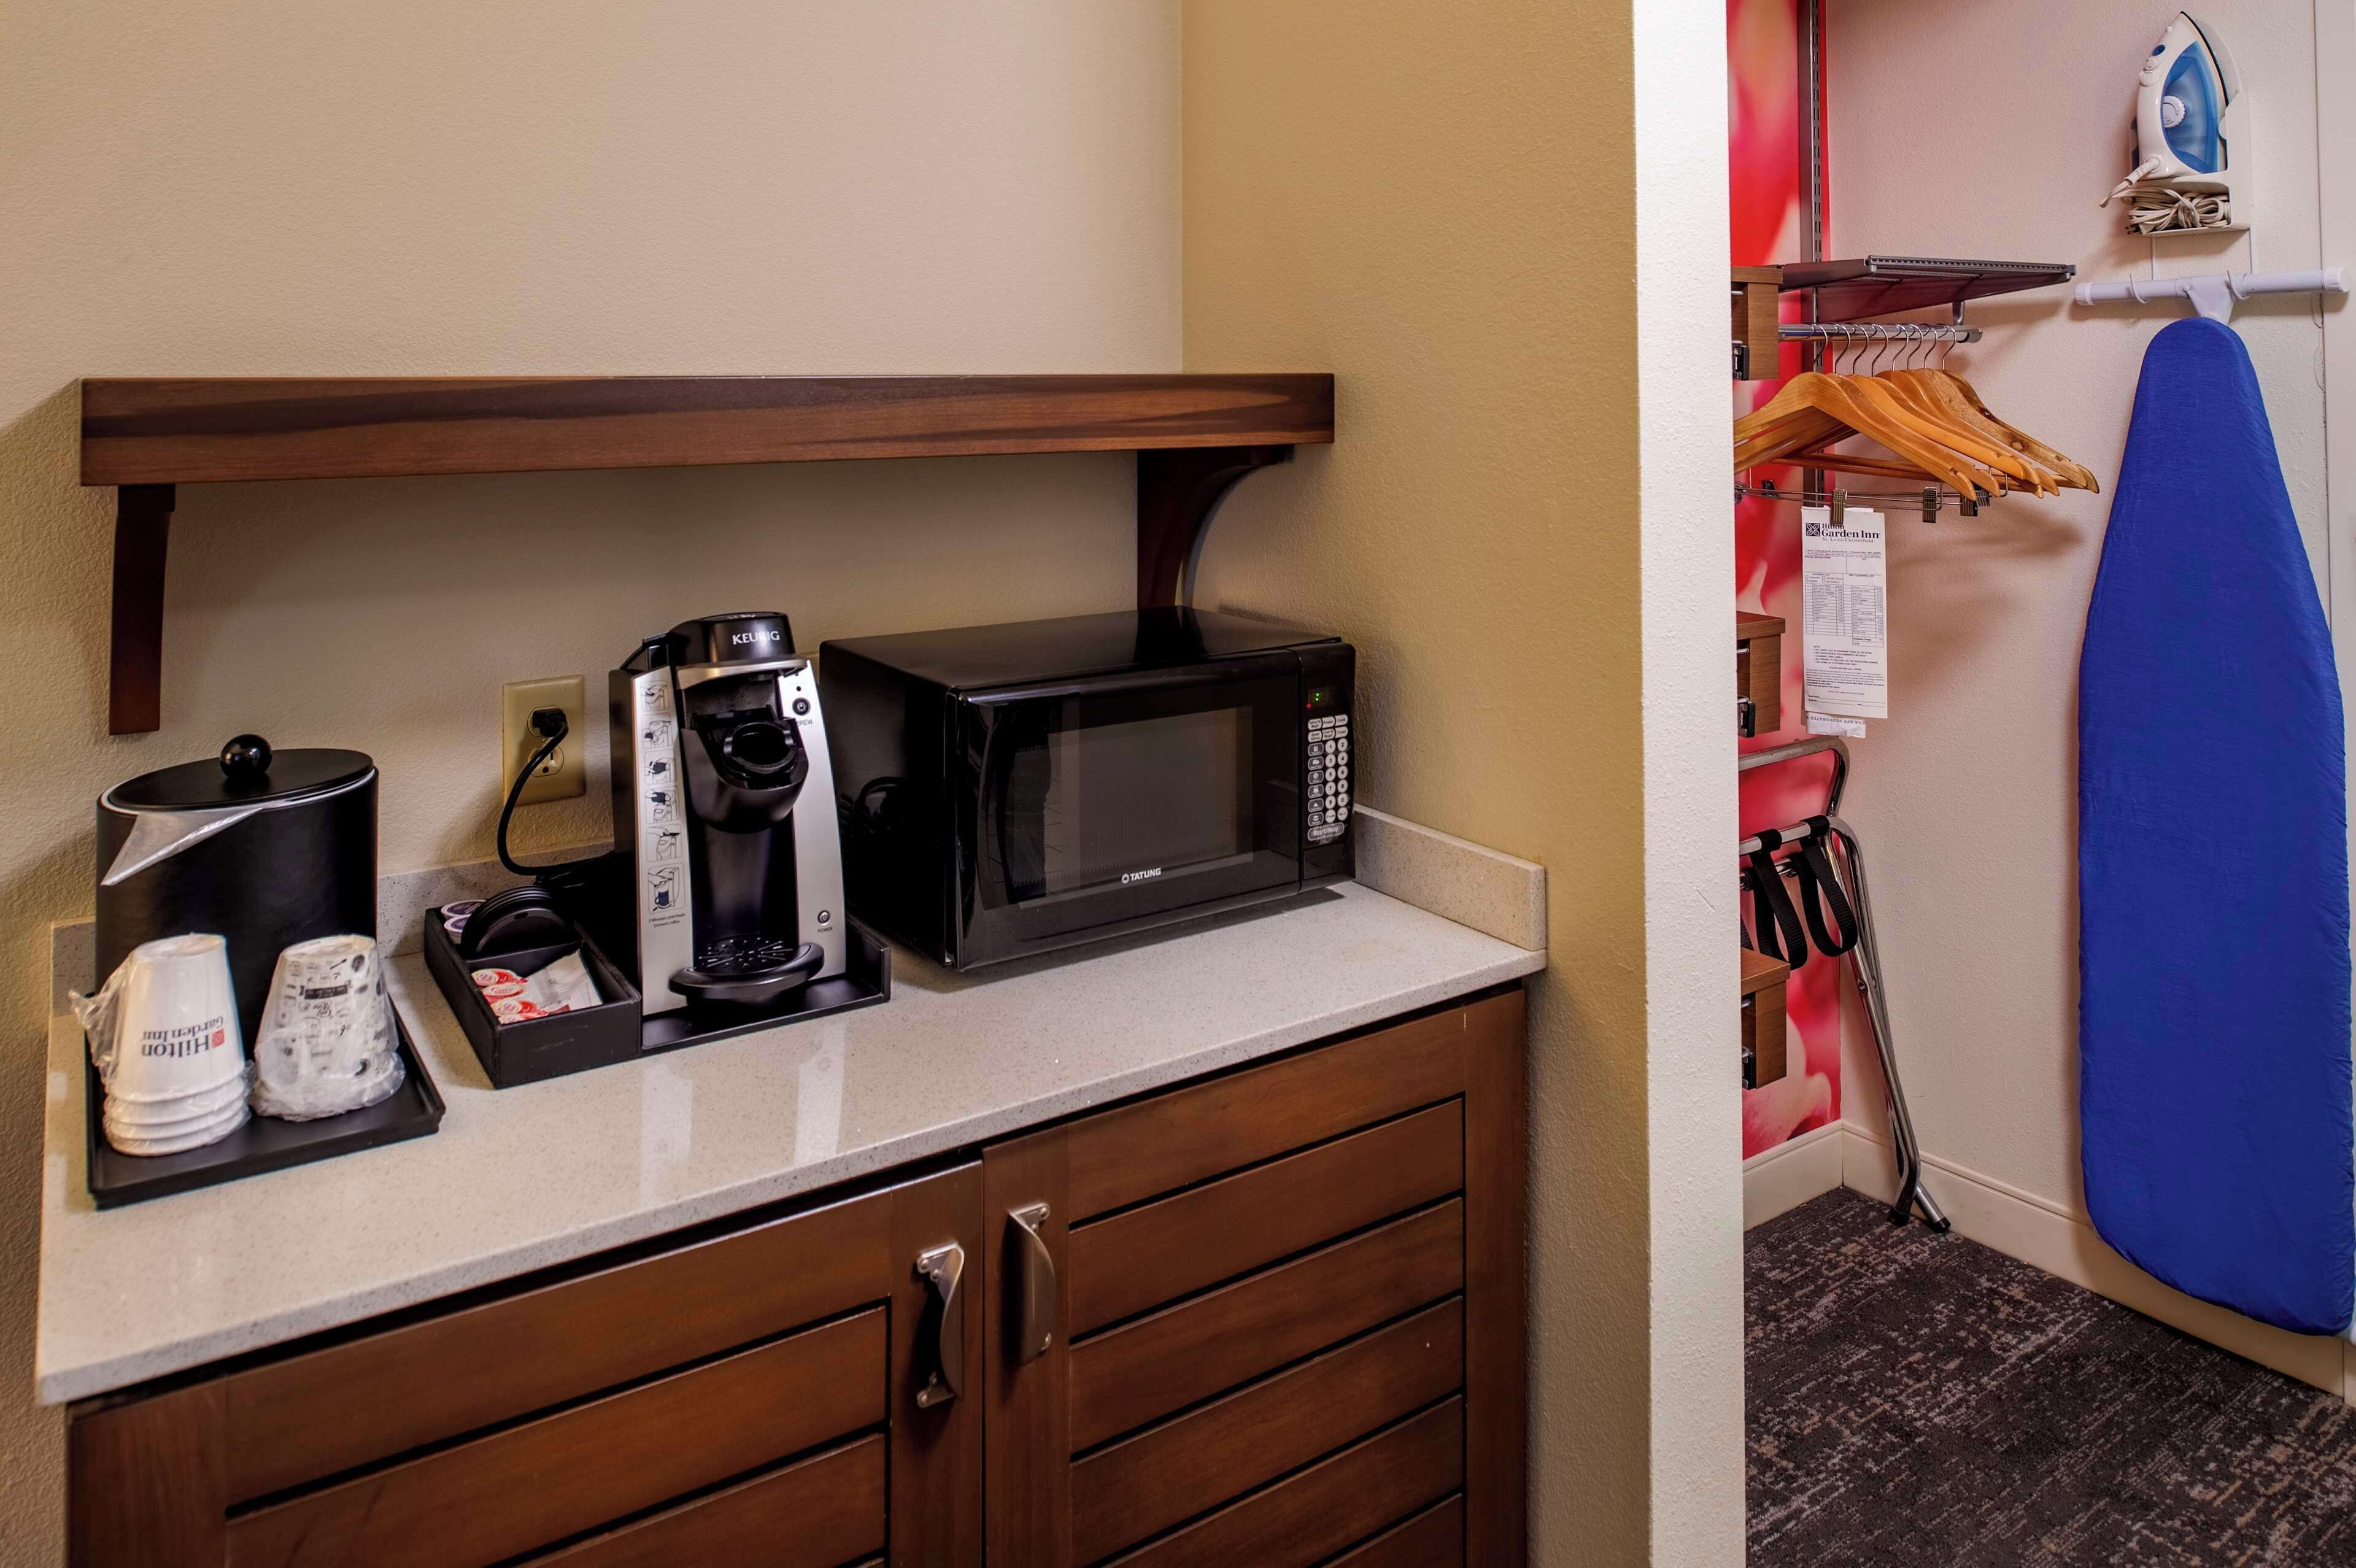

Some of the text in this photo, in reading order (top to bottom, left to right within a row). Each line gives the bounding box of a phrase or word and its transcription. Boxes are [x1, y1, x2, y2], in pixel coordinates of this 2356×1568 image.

[732, 631, 780, 645] KEURIG
[1130, 868, 1161, 881] TATUNG
[142, 1016, 223, 1042] Garden Inn
[142, 1034, 209, 1057] Hilton
